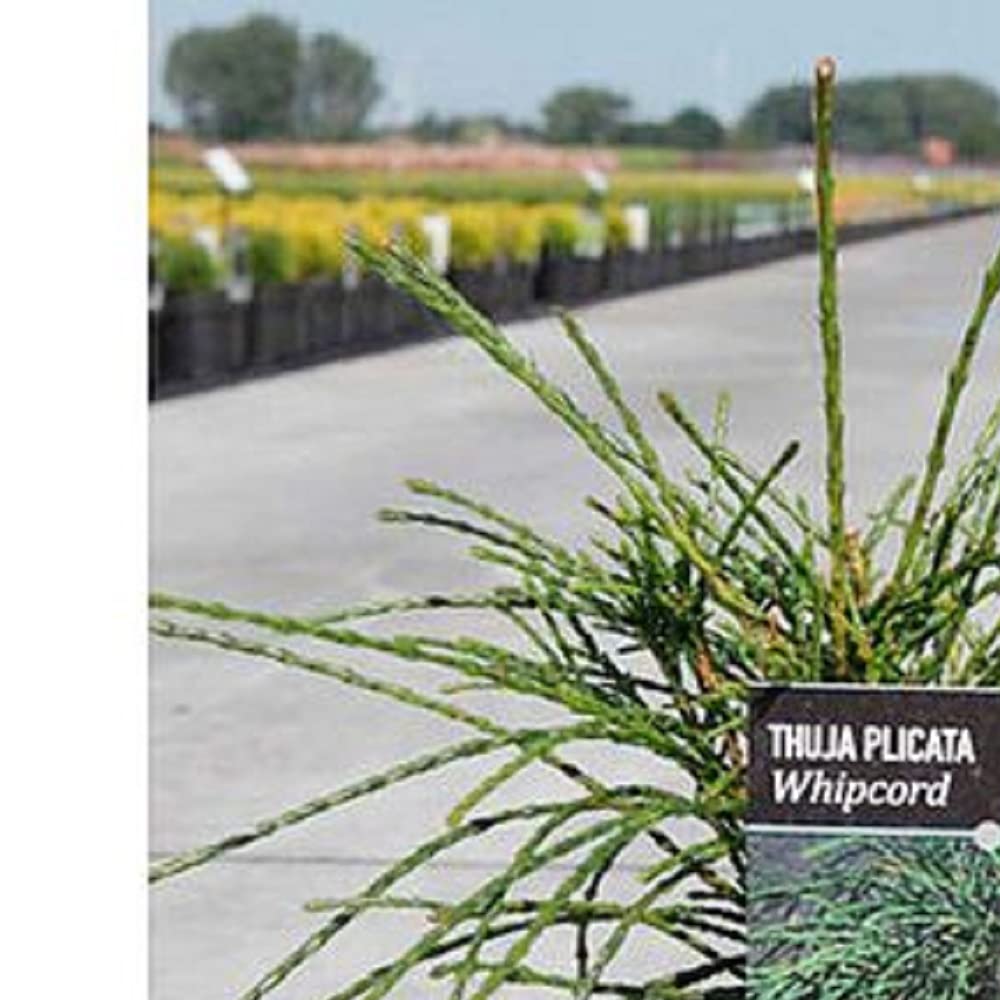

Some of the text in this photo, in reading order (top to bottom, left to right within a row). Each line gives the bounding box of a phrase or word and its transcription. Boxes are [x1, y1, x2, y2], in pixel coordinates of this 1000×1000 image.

[767, 723, 976, 764] THUJA PLICATA
[771, 768, 953, 813] Whipcord
